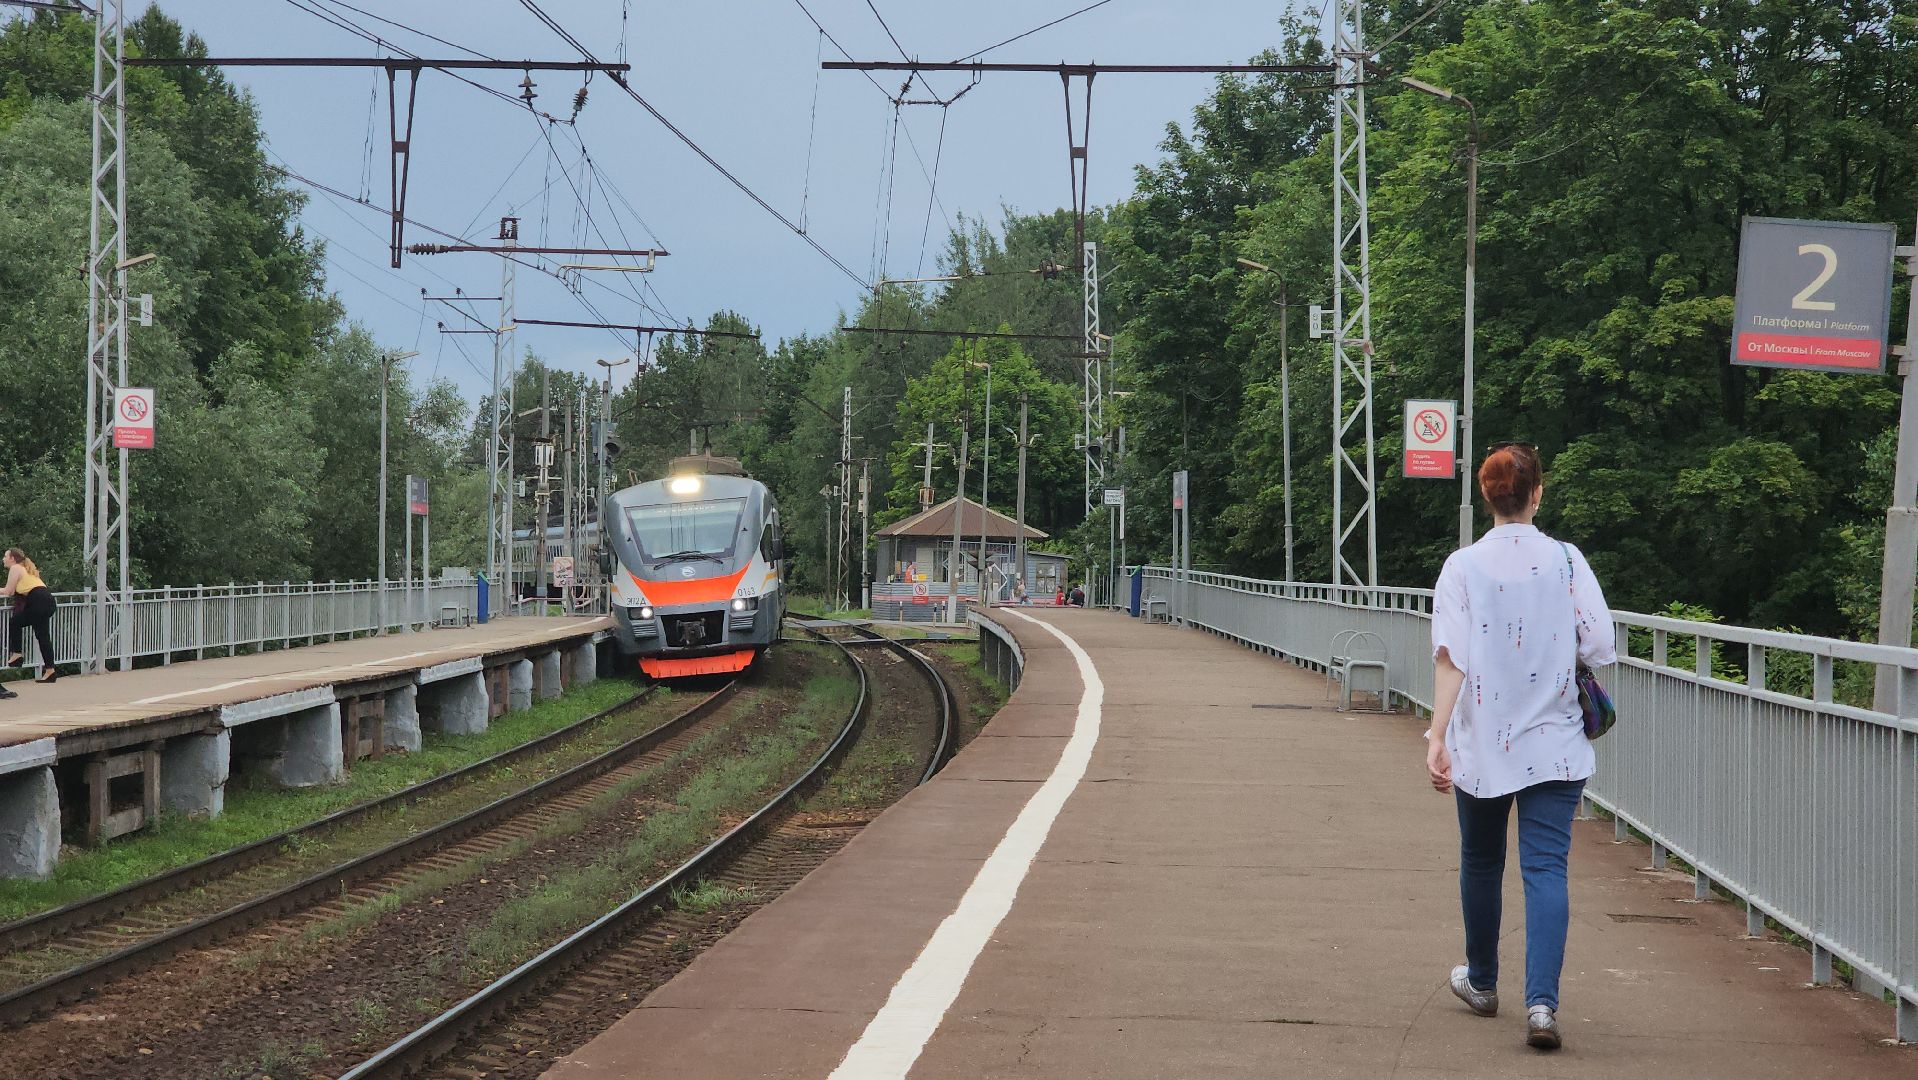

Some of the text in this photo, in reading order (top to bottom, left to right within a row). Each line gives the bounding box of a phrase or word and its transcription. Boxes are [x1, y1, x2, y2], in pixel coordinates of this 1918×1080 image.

[1791, 243, 1838, 311] 2
[1753, 315, 1870, 332] Платформа Platform
[1748, 342, 1871, 358] От Москвы From Moscow
